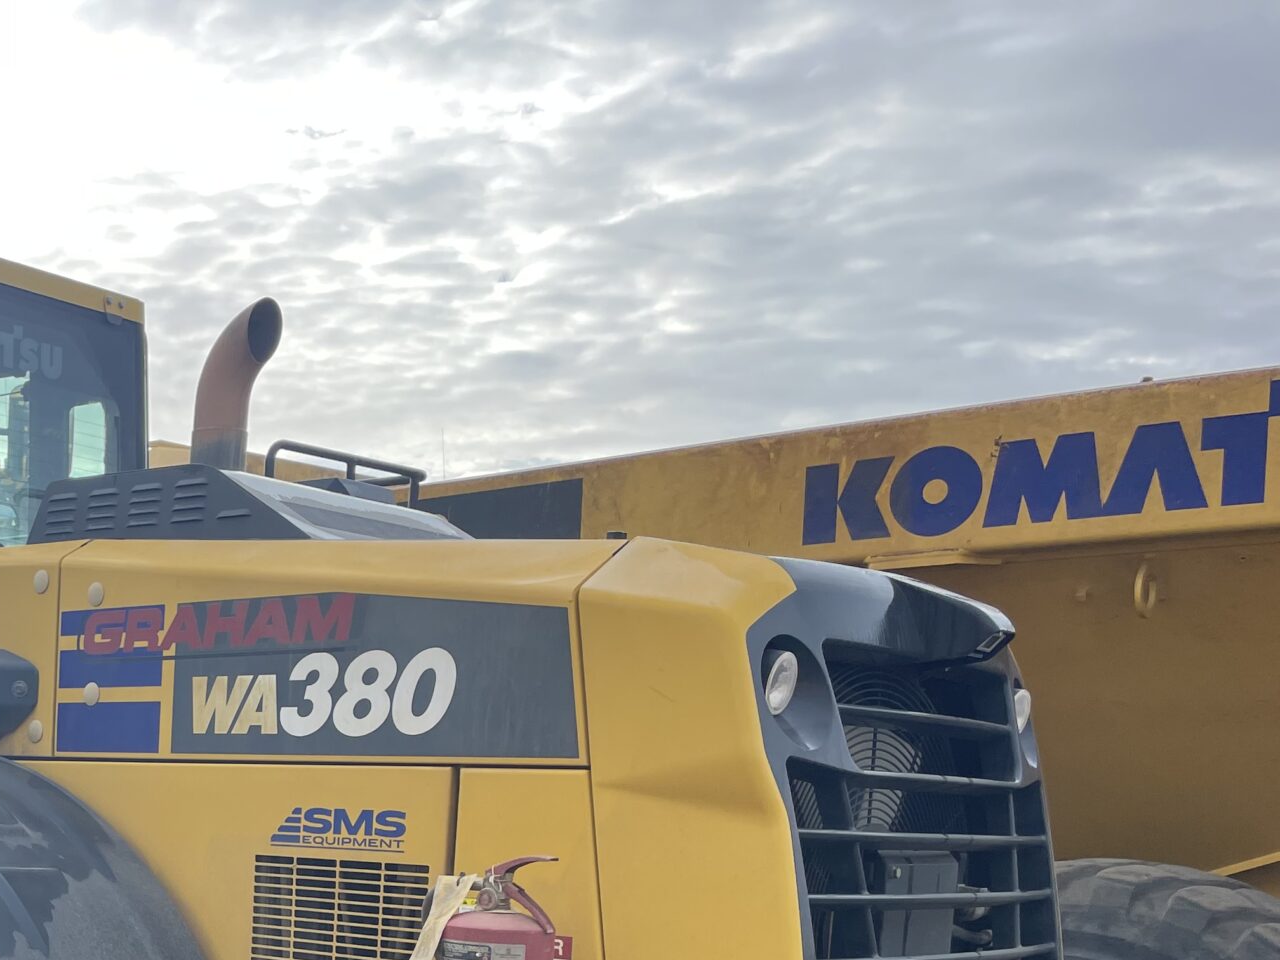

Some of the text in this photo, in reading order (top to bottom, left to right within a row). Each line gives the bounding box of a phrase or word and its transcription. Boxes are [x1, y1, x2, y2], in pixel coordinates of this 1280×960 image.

[83, 593, 357, 656] GRAHAM
[191, 646, 457, 738] WA380
[302, 807, 407, 838] SMS
[302, 835, 405, 849] EQUIPMENT
